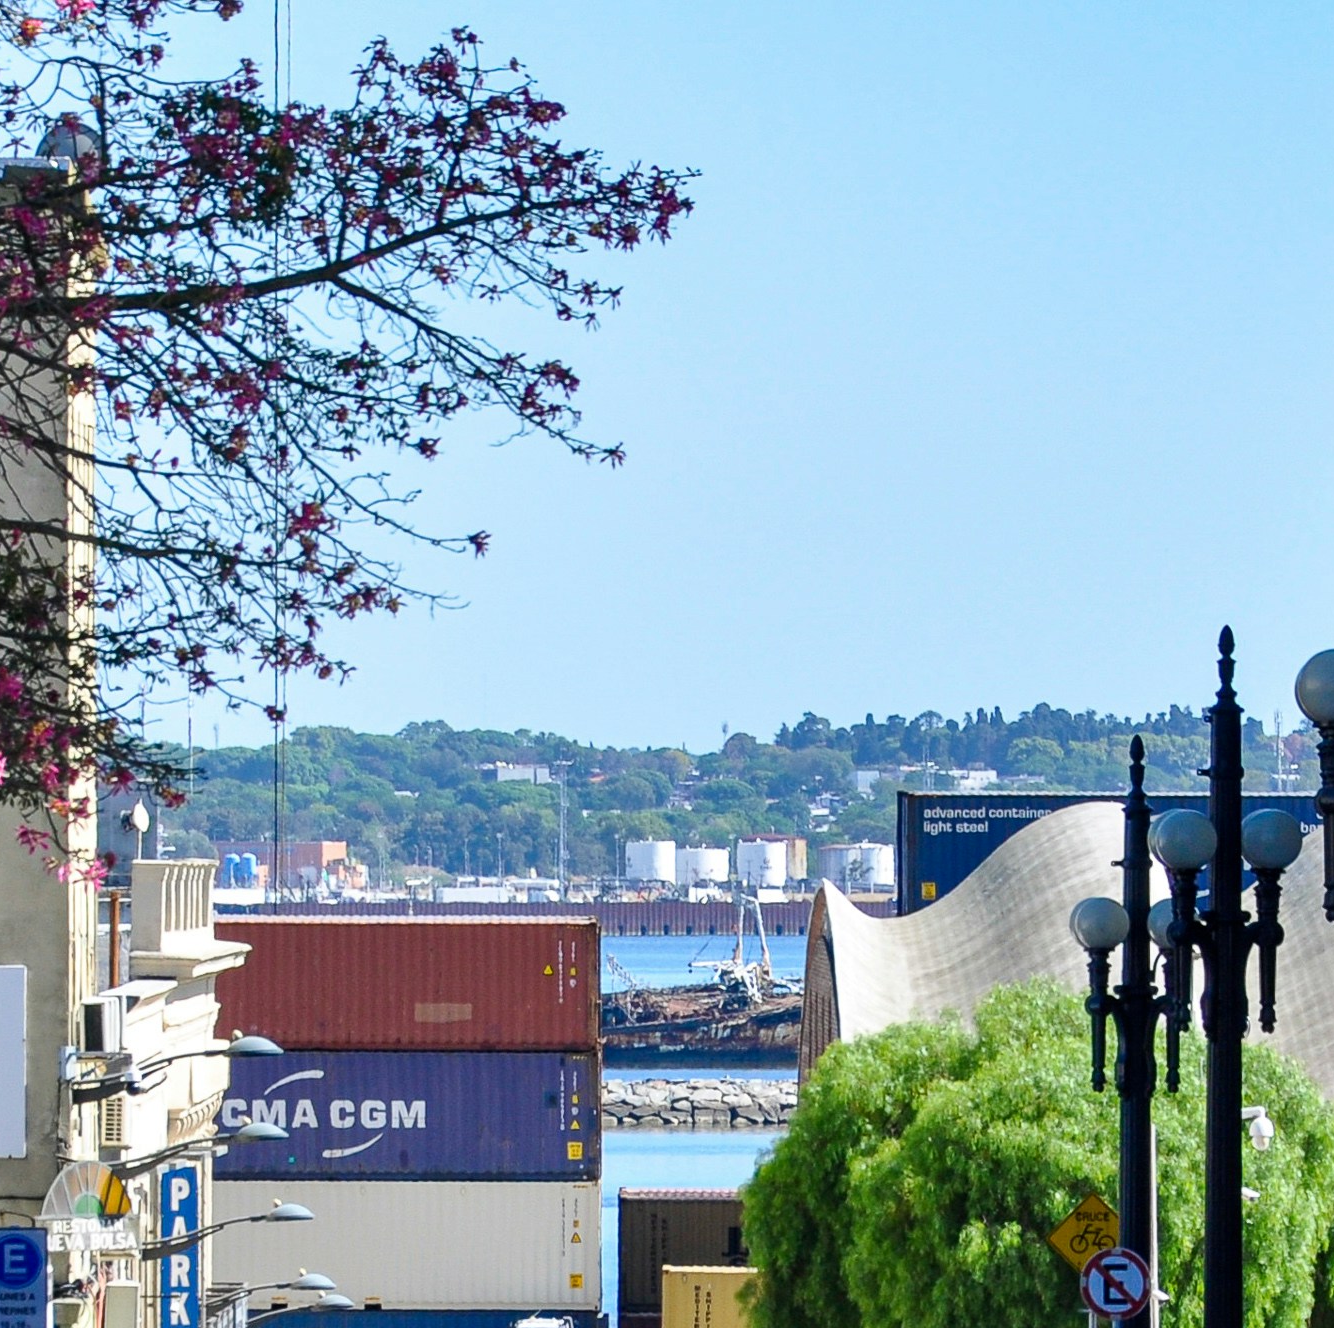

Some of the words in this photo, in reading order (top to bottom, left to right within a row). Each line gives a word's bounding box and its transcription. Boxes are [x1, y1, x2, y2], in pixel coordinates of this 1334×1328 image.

[923, 806, 986, 819] advanced
[923, 820, 953, 836] light
[955, 821, 989, 833] steel
[221, 1098, 319, 1128] CMA
[329, 1099, 427, 1129] CGM
[1075, 1211, 1110, 1222] CRUCE
[46, 1234, 85, 1251] UEVA
[90, 1232, 138, 1250] BOLSA
[3, 1243, 27, 1274] E
